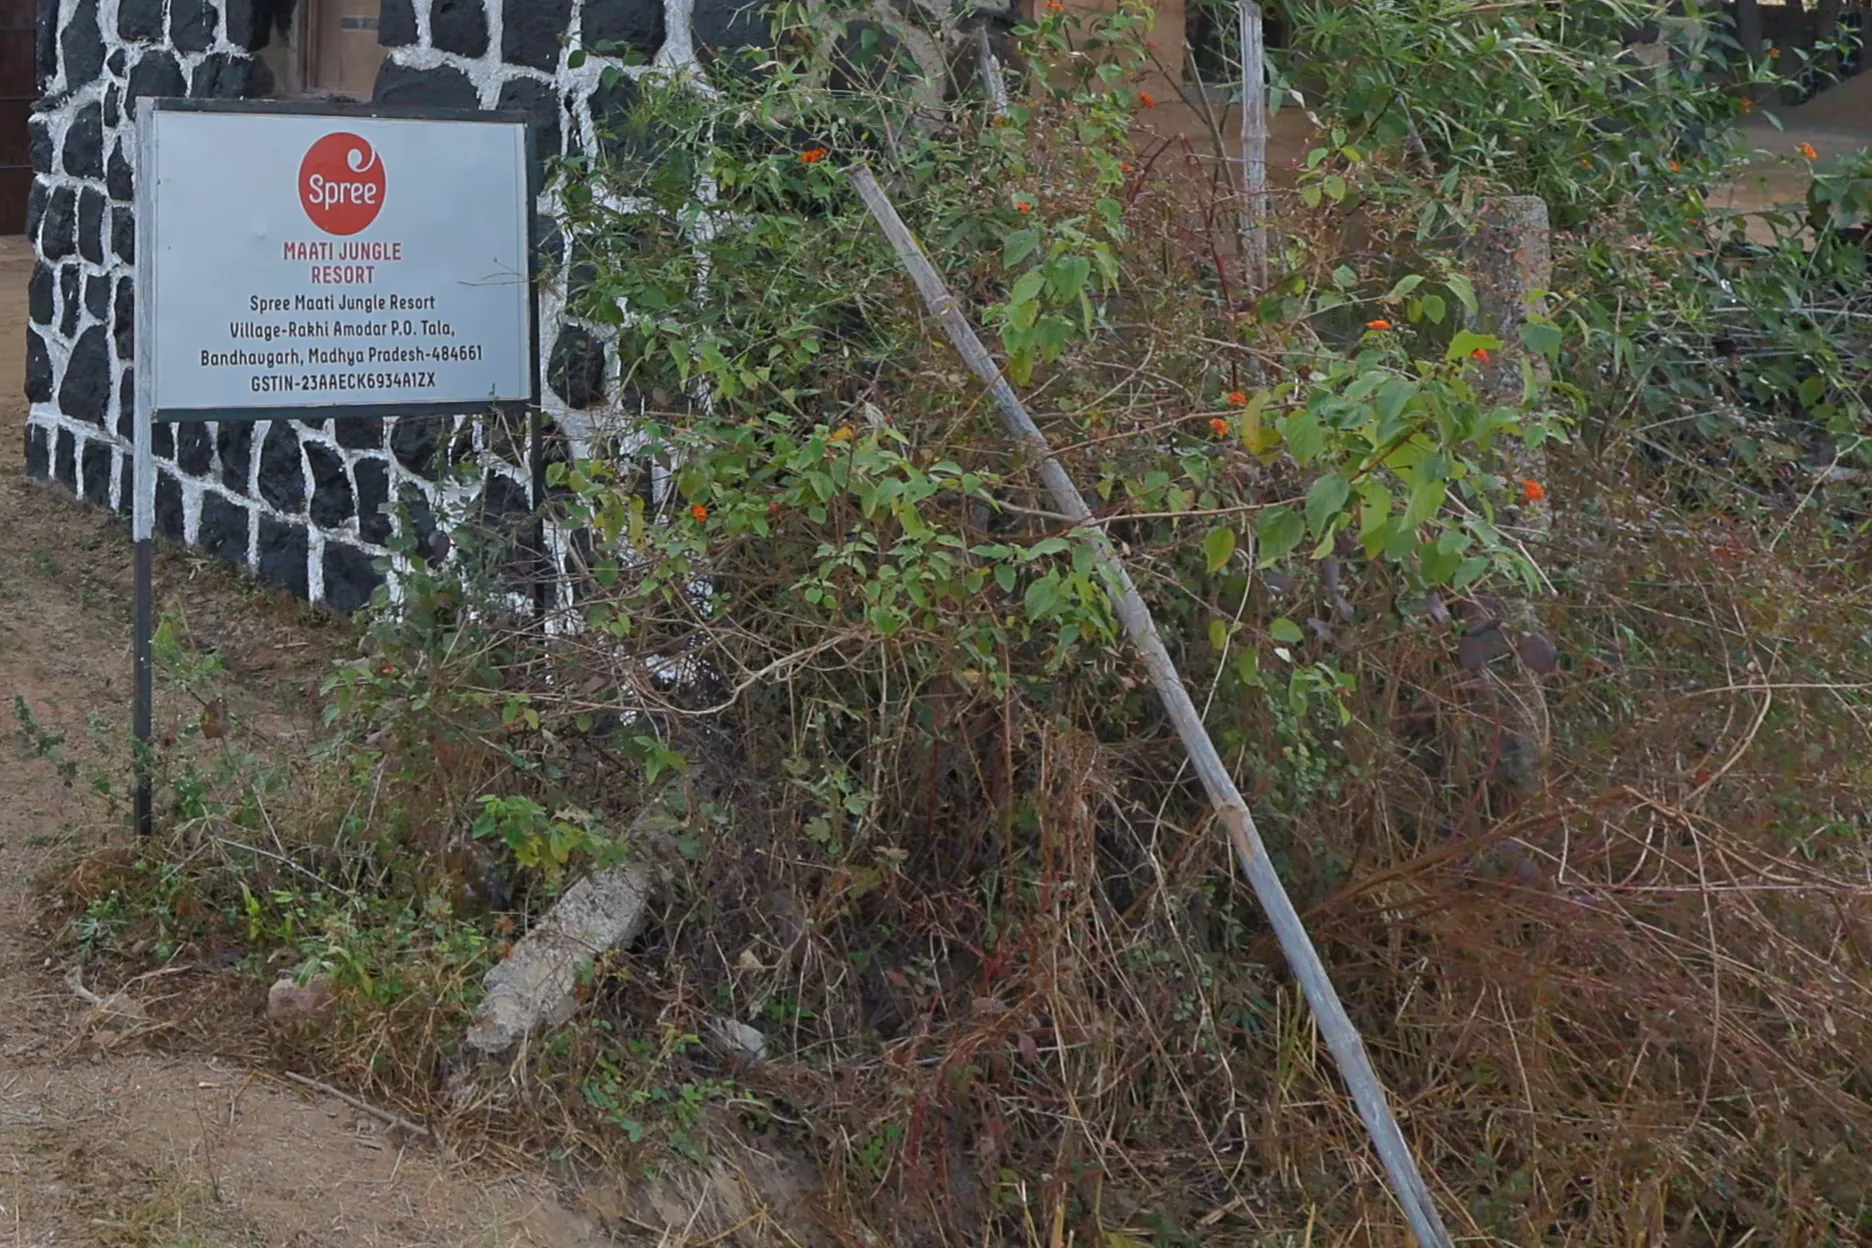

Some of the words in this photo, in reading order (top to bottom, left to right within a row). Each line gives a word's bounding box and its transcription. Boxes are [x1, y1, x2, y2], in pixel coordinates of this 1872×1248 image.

[309, 173, 377, 211] Spree
[283, 242, 333, 260] MAATI
[338, 242, 402, 260] JUNGLE
[311, 265, 375, 284] RESORT
[250, 295, 290, 314] Spree
[295, 295, 334, 310] Maati
[338, 294, 385, 313] Jungle
[390, 294, 435, 310] Resort
[230, 321, 328, 341] Village-Rakhi
[333, 320, 387, 336] Amodar
[391, 320, 416, 335] P.O.
[421, 320, 455, 337] Tala,
[308, 347, 364, 366] Madhya
[368, 345, 482, 362] Pradesh-484661
[251, 372, 436, 391] GSTIN-23AAECK6934A1ZX
